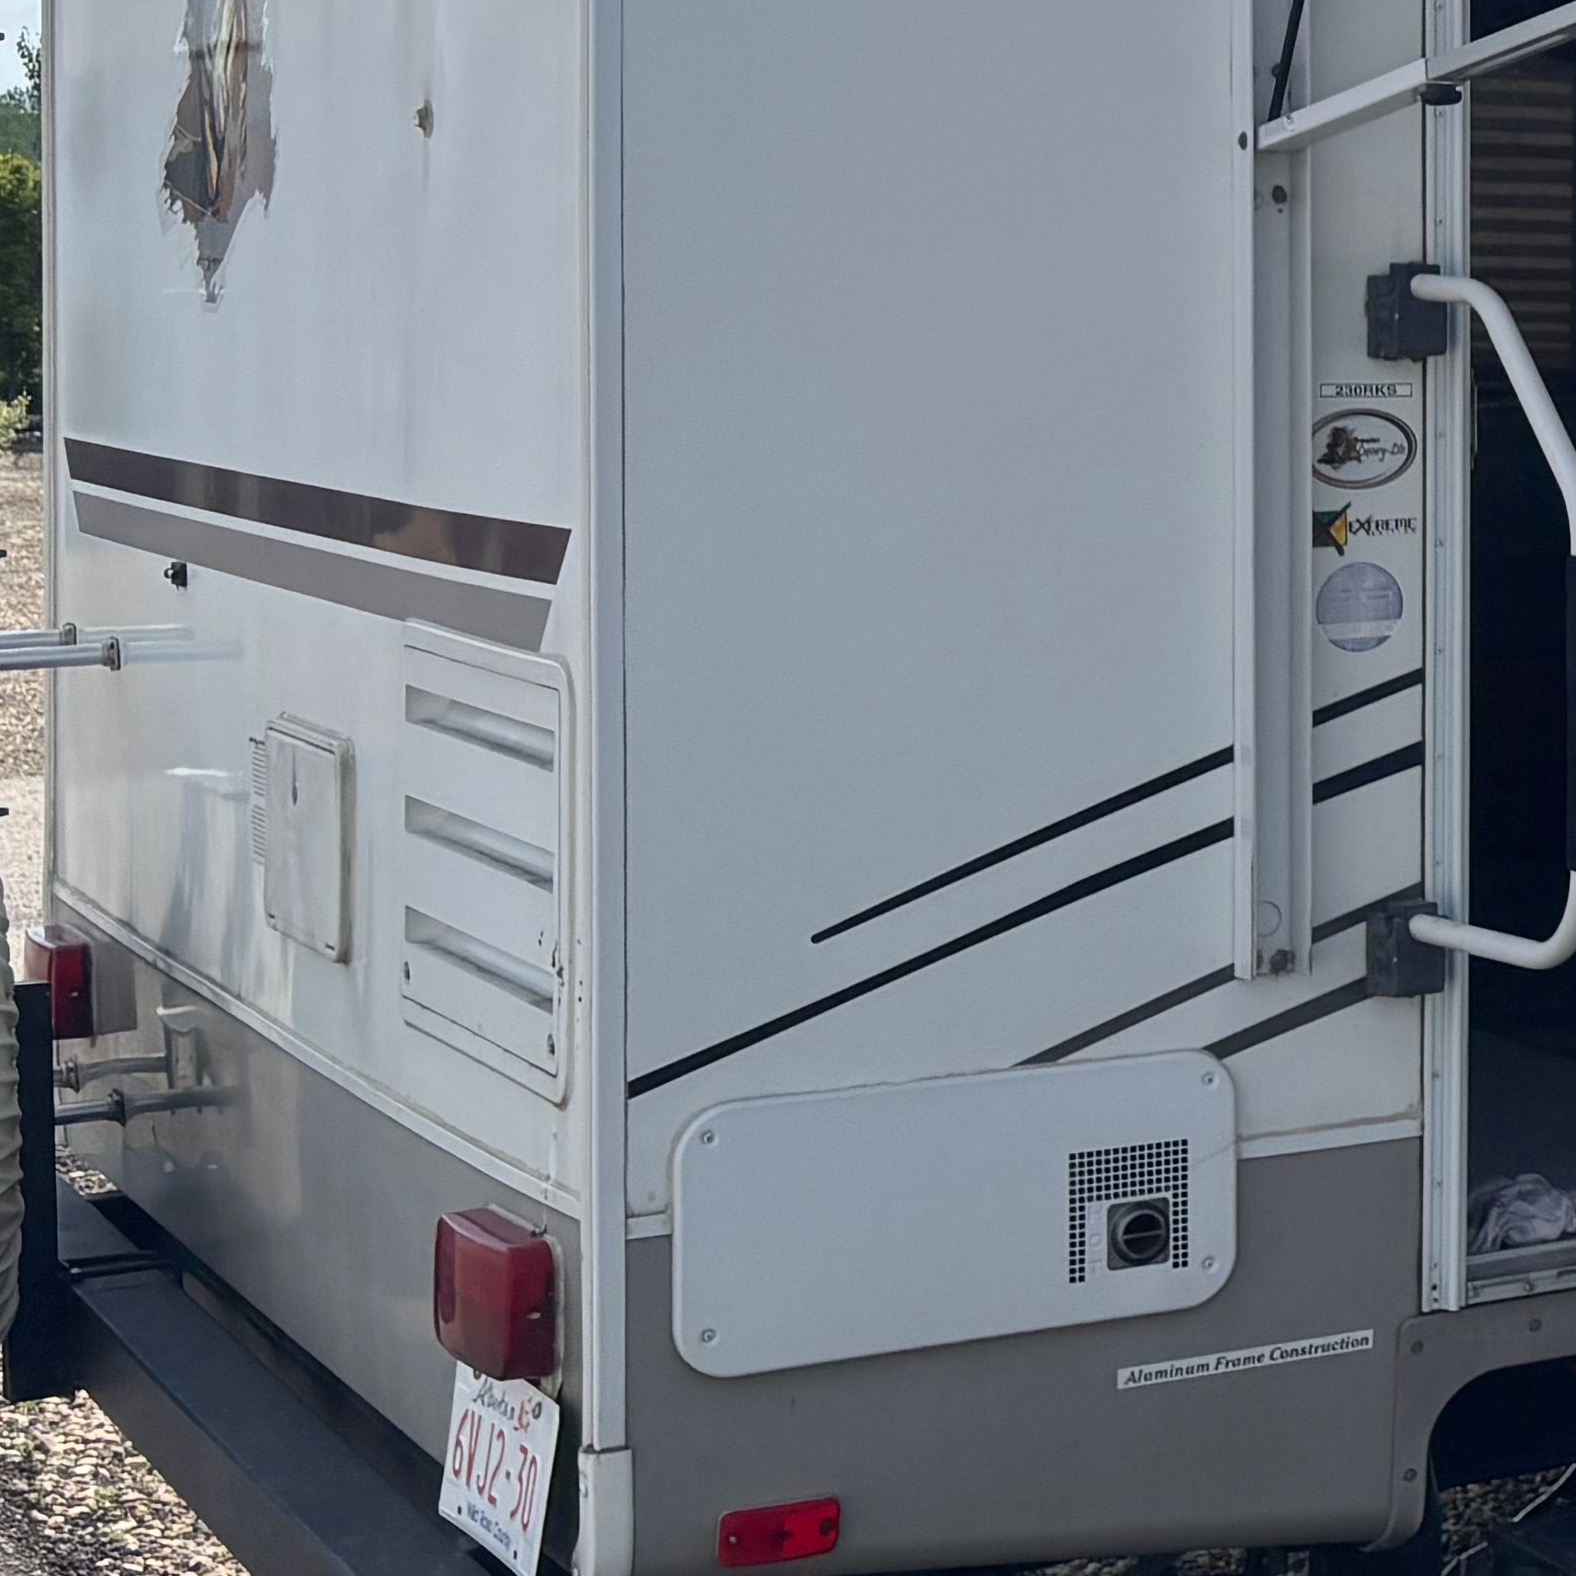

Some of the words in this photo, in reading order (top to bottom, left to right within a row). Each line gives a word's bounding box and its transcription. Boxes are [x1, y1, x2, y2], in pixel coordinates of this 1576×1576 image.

[1124, 1363, 1210, 1386] Aluminum
[1214, 1355, 1265, 1374] Frame
[1269, 1336, 1370, 1362] Construction
